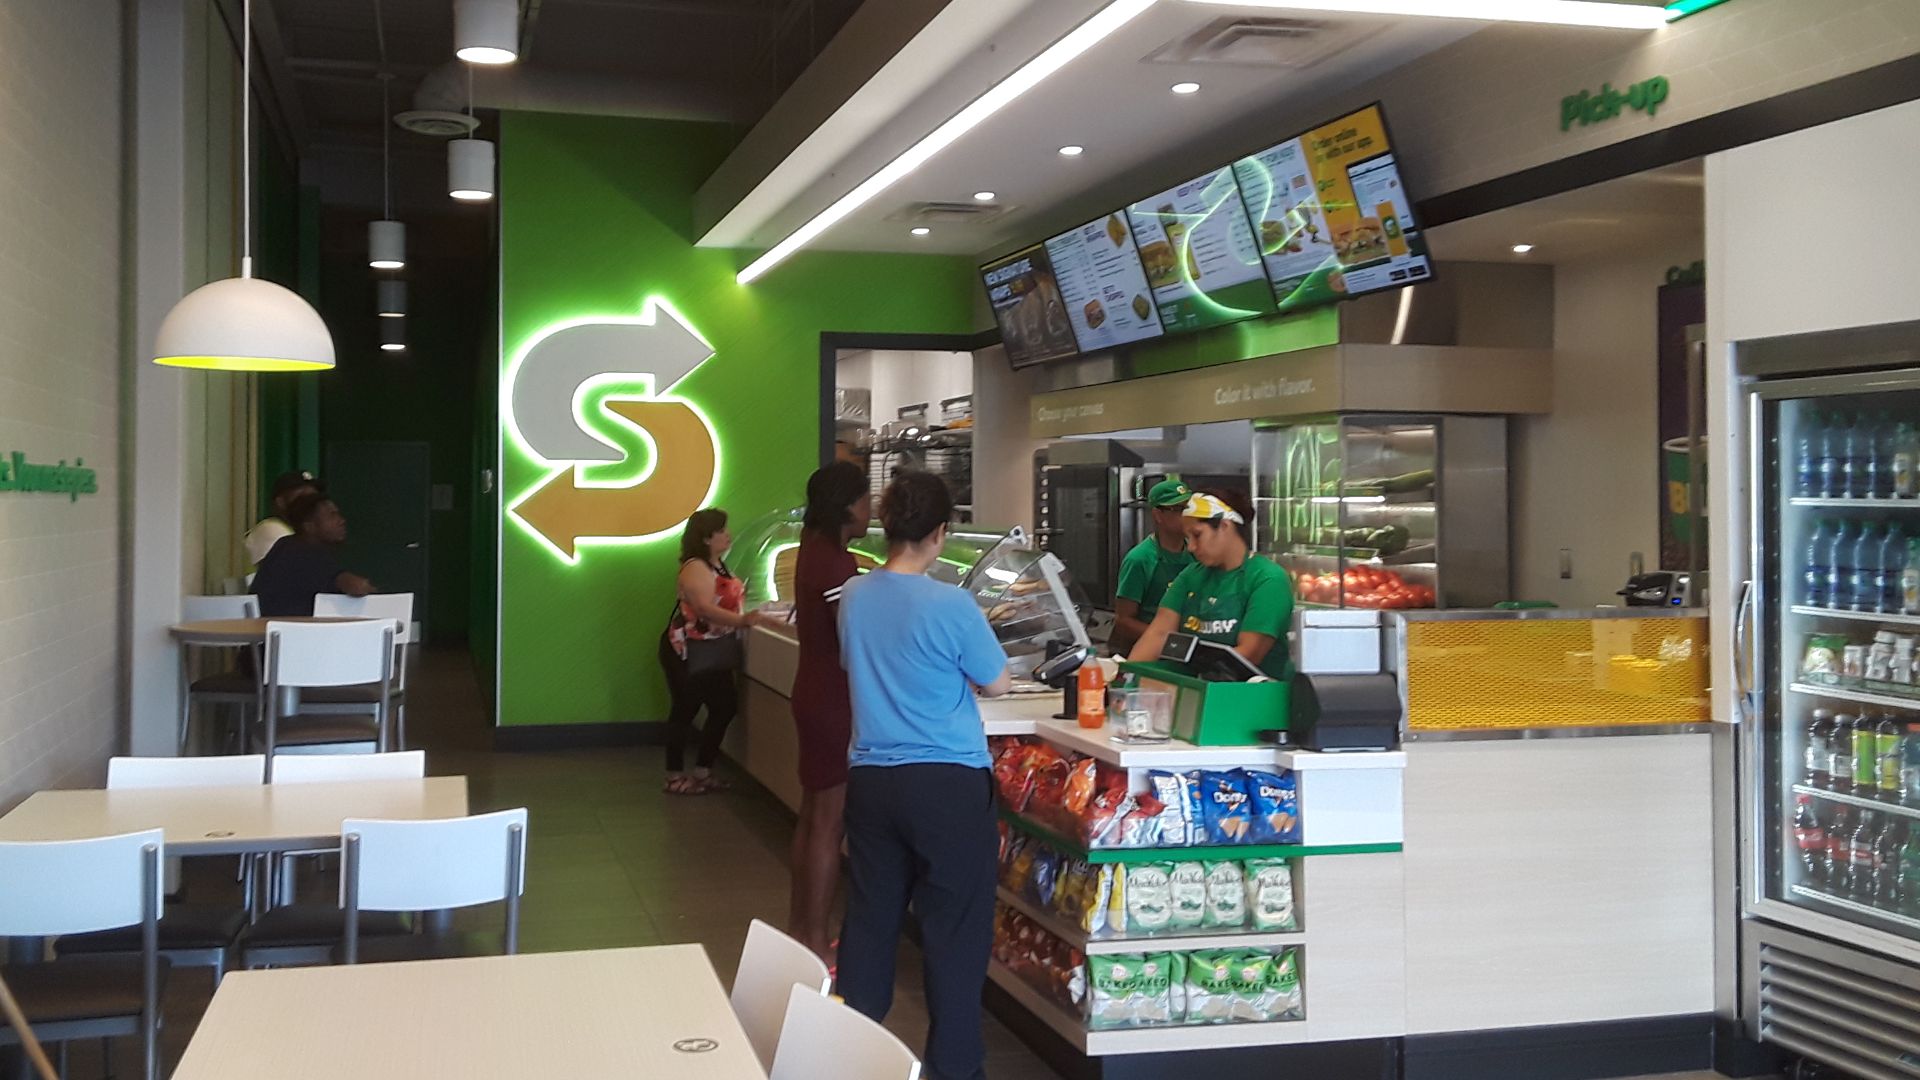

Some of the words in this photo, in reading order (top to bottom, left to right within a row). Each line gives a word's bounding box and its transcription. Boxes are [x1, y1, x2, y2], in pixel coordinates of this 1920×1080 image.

[1561, 75, 1668, 132] Pick-up
[1216, 387, 1241, 405] Color
[1252, 379, 1277, 398] with
